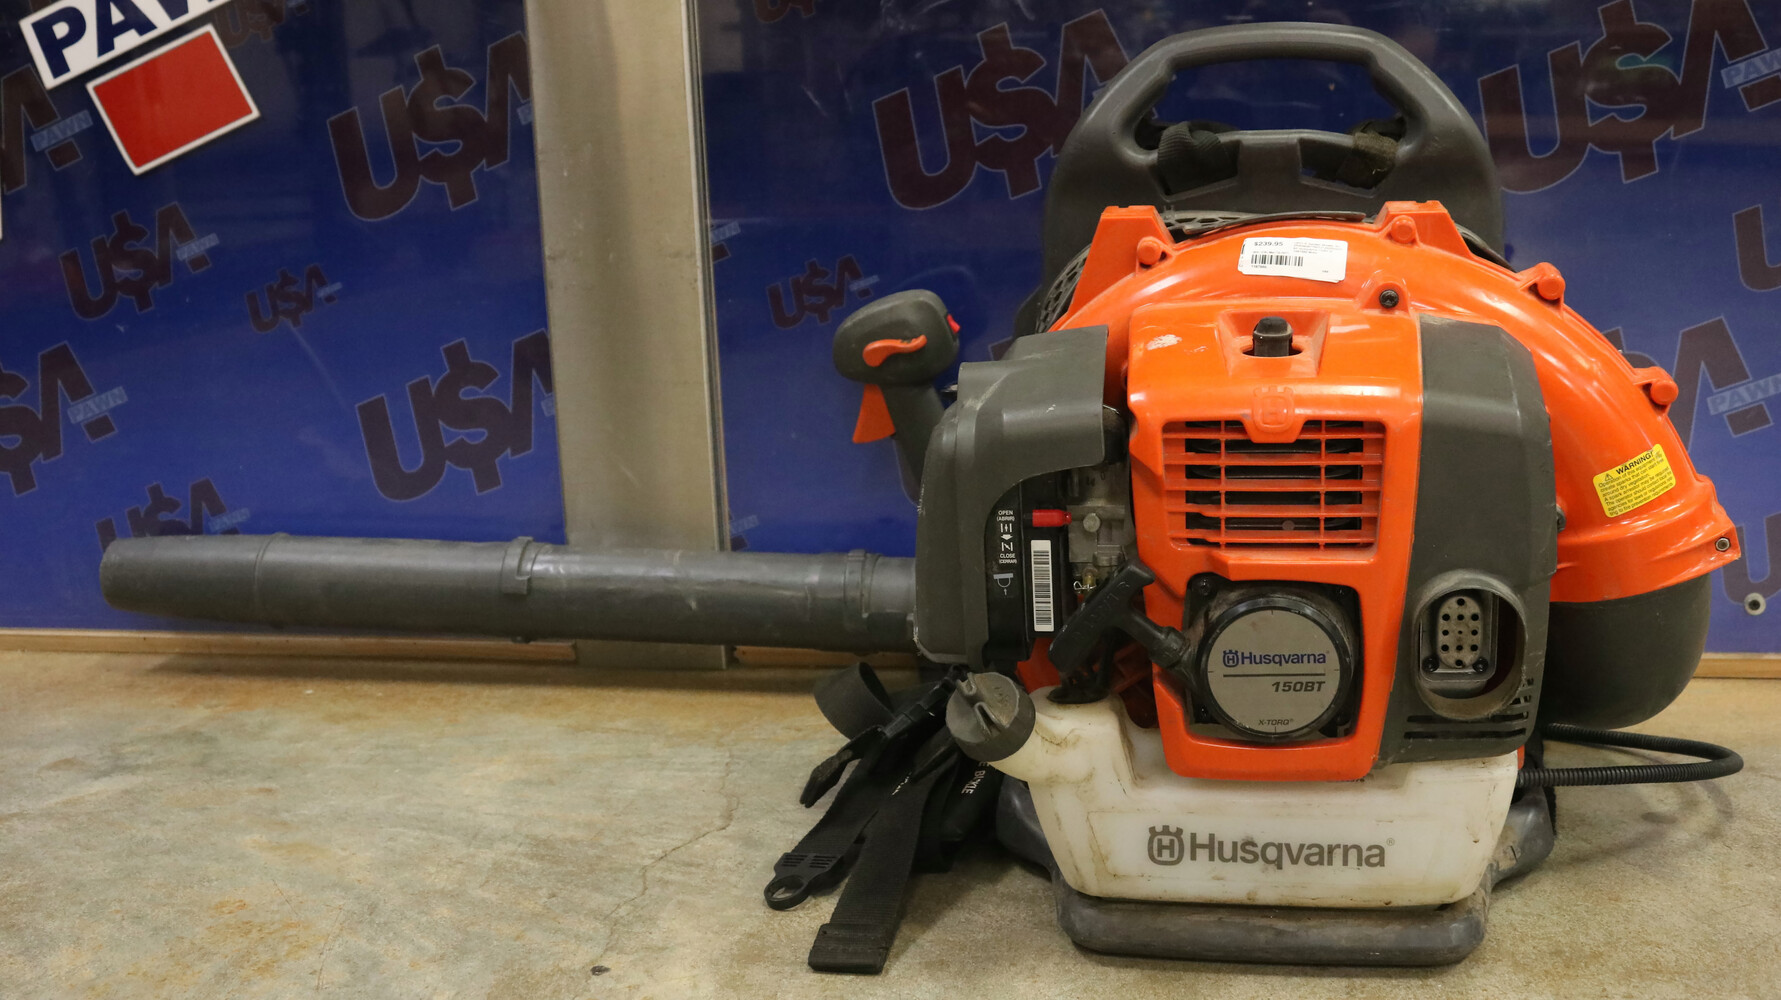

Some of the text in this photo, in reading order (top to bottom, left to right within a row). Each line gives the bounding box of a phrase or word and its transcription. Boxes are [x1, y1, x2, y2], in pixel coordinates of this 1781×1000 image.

[31, 0, 214, 79] PA
[1616, 451, 1653, 475] WARNING!
[1241, 652, 1326, 667] Husqvarna
[1271, 681, 1326, 692] 150BT
[1190, 833, 1386, 870] Husqvarna
